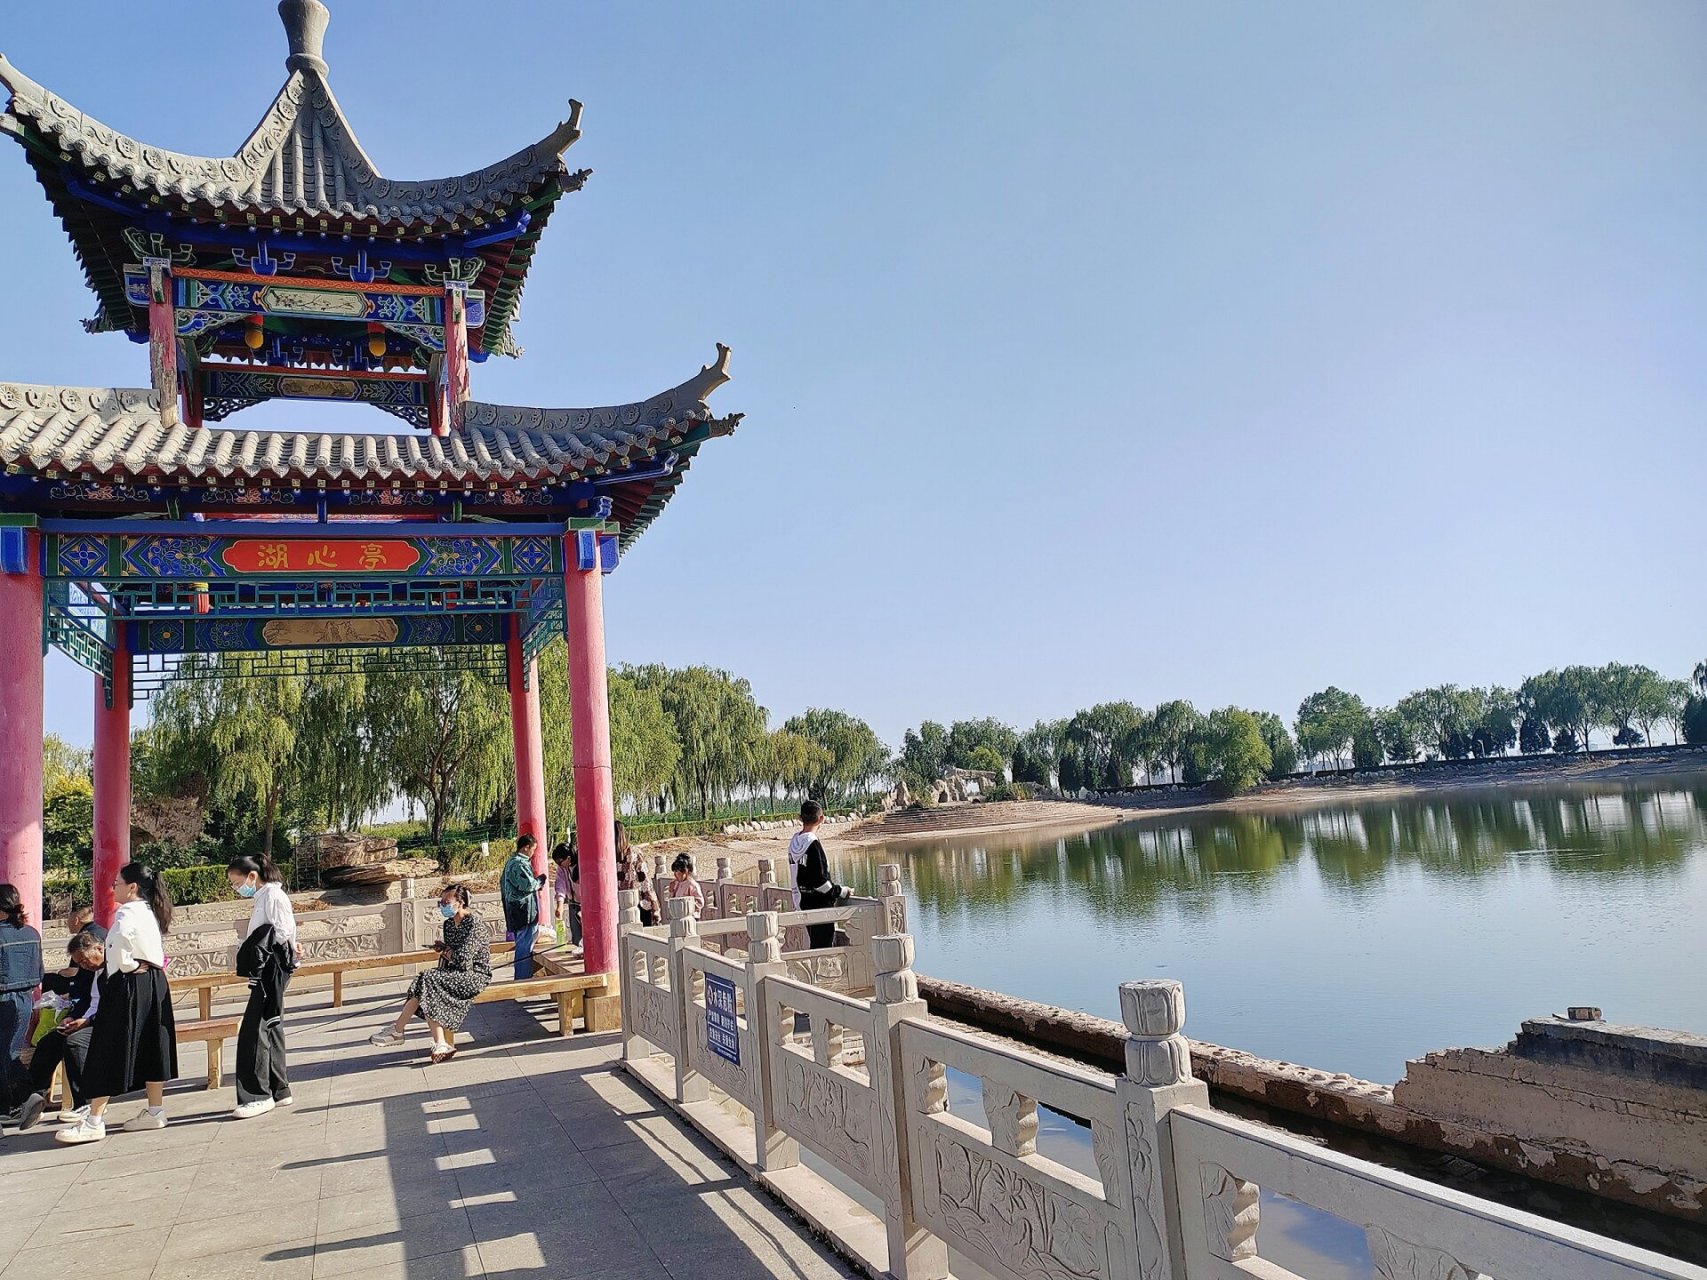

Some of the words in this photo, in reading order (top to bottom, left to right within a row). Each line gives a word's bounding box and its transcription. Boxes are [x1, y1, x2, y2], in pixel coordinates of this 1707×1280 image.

[257, 543, 387, 570] 湖心亭
[713, 988, 733, 1013] 水深危险
